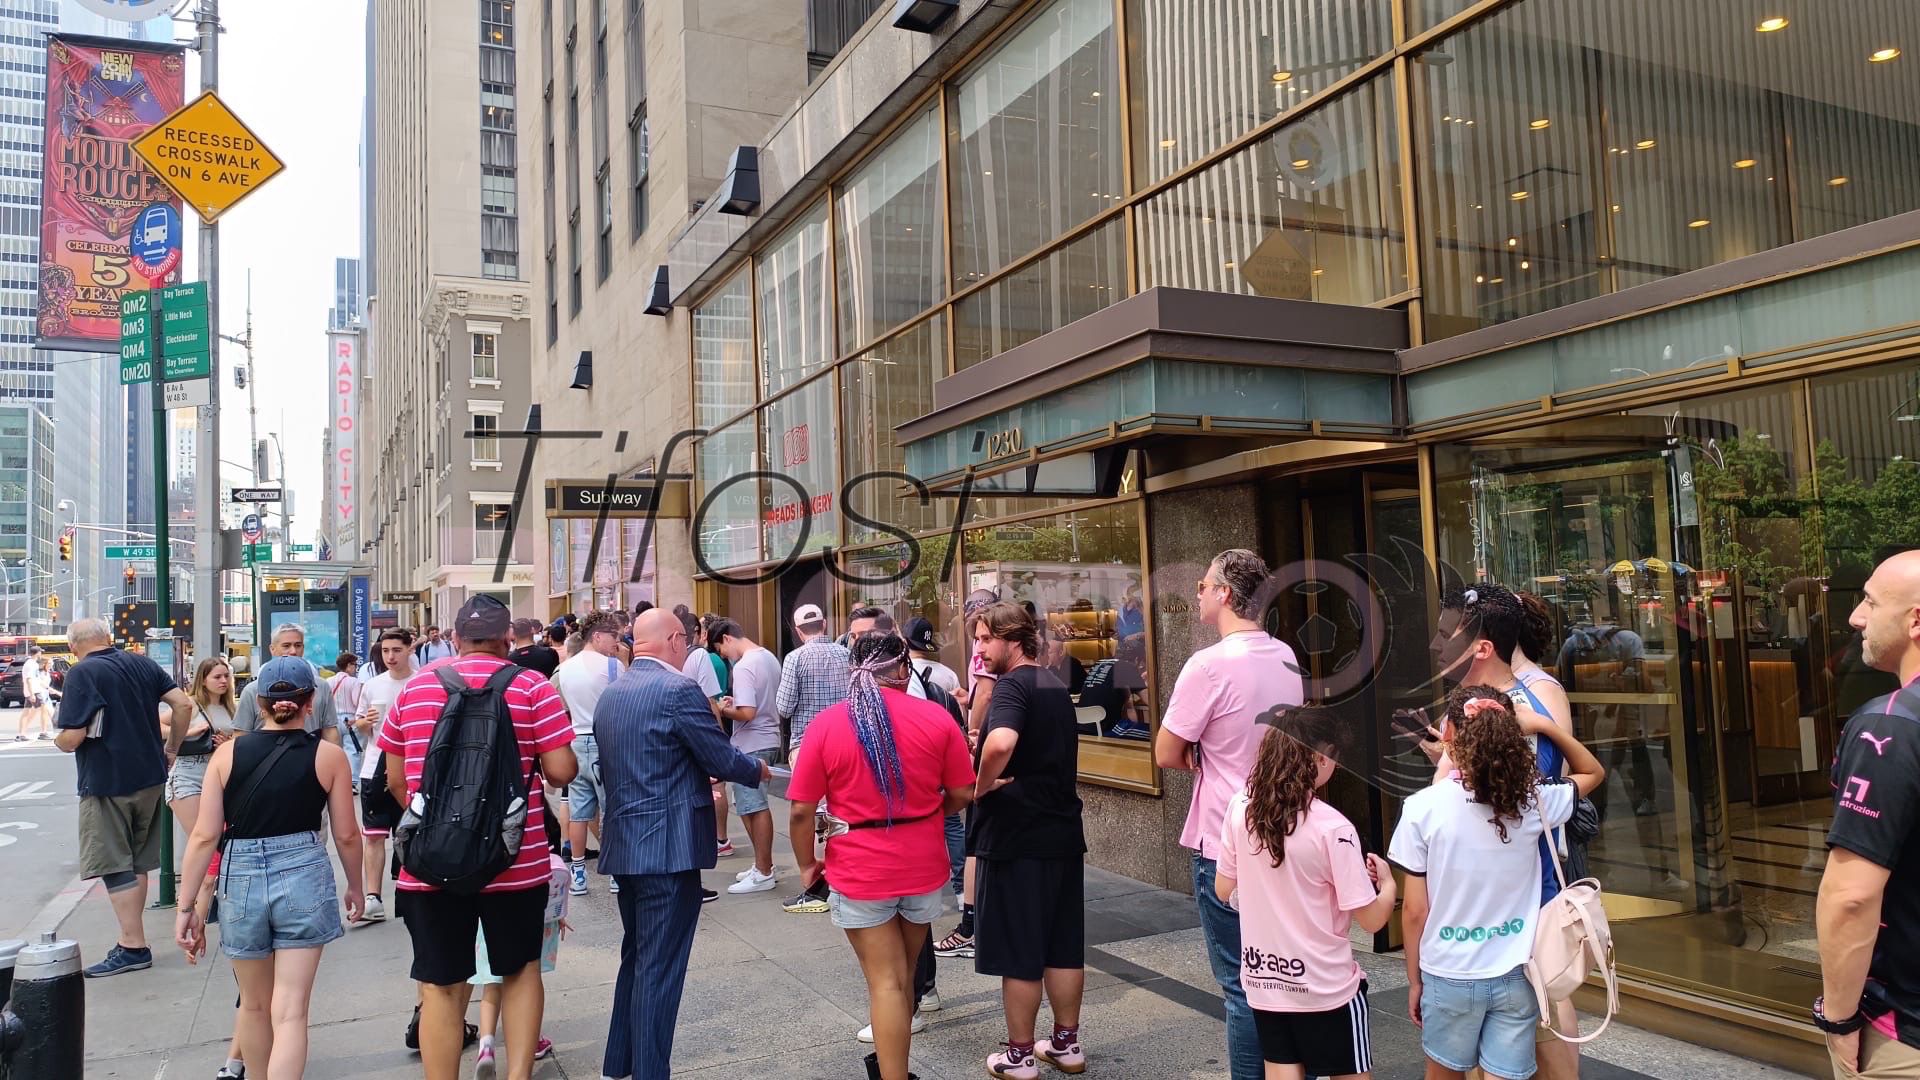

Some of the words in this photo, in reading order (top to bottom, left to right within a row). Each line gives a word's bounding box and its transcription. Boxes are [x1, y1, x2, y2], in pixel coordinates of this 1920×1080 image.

[101, 51, 134, 65] NEW
[101, 62, 133, 74] YORK
[101, 70, 132, 82] CITY
[165, 127, 254, 151] RECESSED
[157, 145, 261, 171] CROSSWALK
[59, 163, 155, 200] ROUGE
[168, 164, 191, 180] ON
[201, 169, 211, 182] 6
[218, 171, 250, 187] AVE
[91, 254, 130, 287] 5
[134, 257, 144, 271] NO
[144, 253, 176, 276] STANDING
[163, 290, 174, 300] Bay
[175, 287, 194, 297] Terrace
[123, 295, 147, 315] QM2
[179, 310, 193, 320] Neck
[122, 317, 145, 337] QM3
[122, 340, 145, 359] QM4
[122, 361, 151, 382] QM20
[166, 358, 177, 368] Bay
[178, 356, 198, 366] Terrace
[338, 341, 354, 432] RADIO
[987, 428, 1023, 461] 1230
[338, 447, 354, 520] CITY
[240, 491, 253, 499] ONE
[260, 491, 276, 499] WAY
[580, 490, 642, 507] Subway
[122, 548, 129, 556] W
[132, 548, 143, 556] 49
[145, 548, 154, 556] St
[355, 588, 364, 596] 6
[354, 596, 364, 625] Avenue
[1162, 604, 1189, 613] SIMON
[1267, 953, 1306, 977] a29
[1262, 982, 1285, 991] SERVICE
